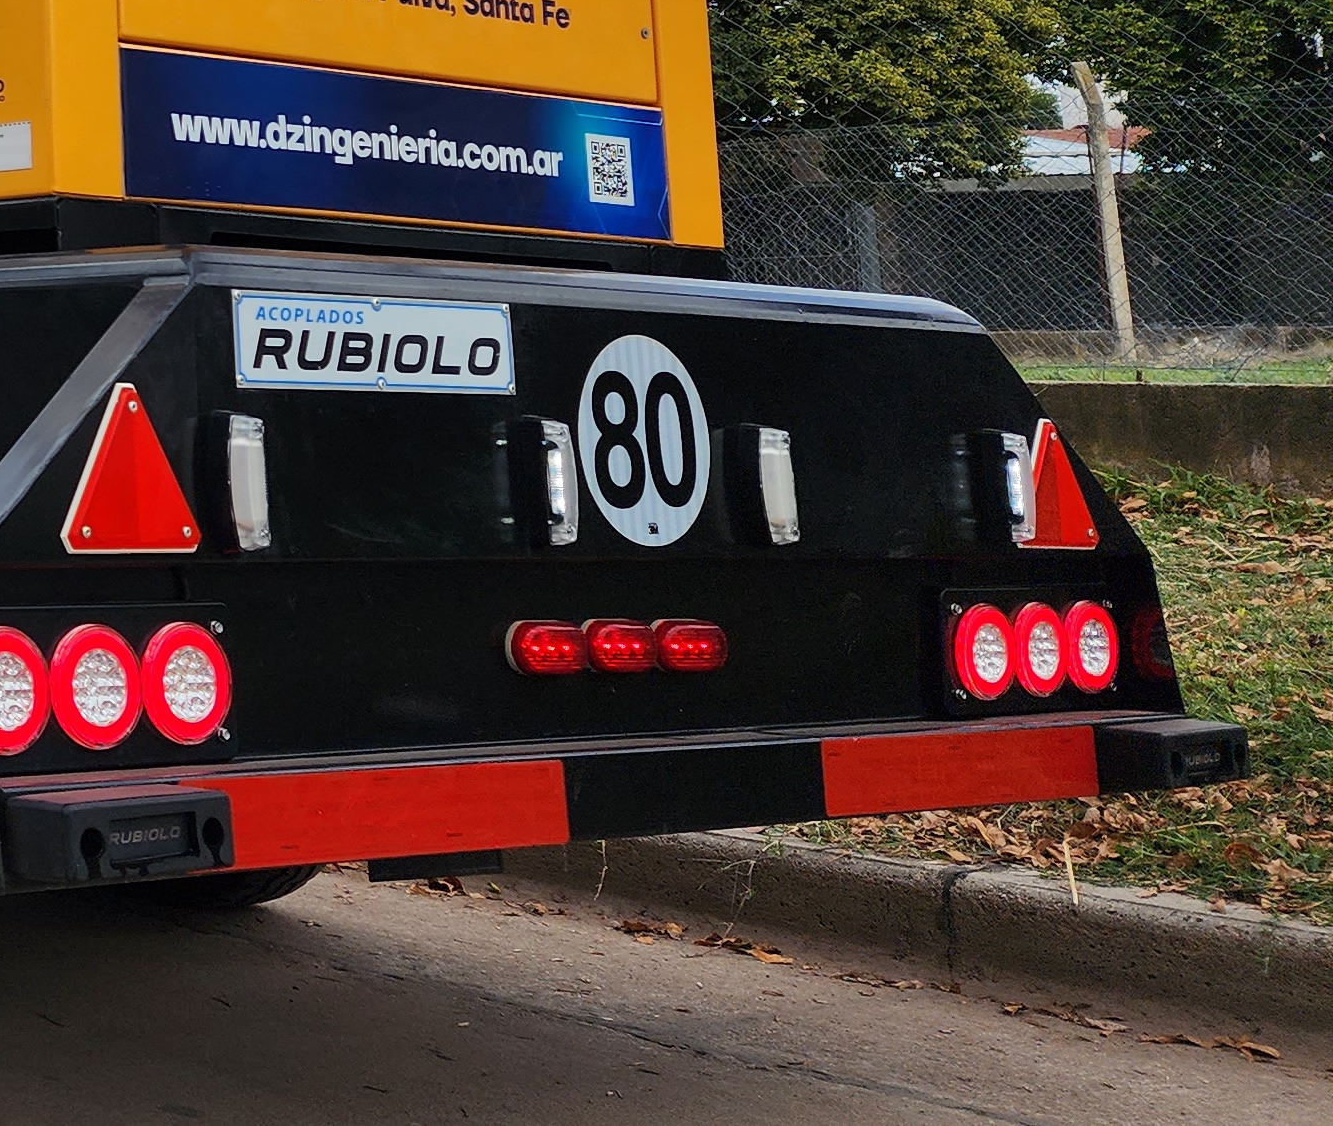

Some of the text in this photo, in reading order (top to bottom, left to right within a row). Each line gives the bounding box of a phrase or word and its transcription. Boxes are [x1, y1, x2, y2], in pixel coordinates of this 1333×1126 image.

[542, 0, 571, 29] Fe
[170, 111, 563, 178] www.dzingenieria.com.ar
[255, 306, 365, 326] ACOPLADOS
[253, 327, 501, 376] RUBIOLO
[591, 370, 697, 509] 80
[109, 825, 181, 845] RUBIOLO
